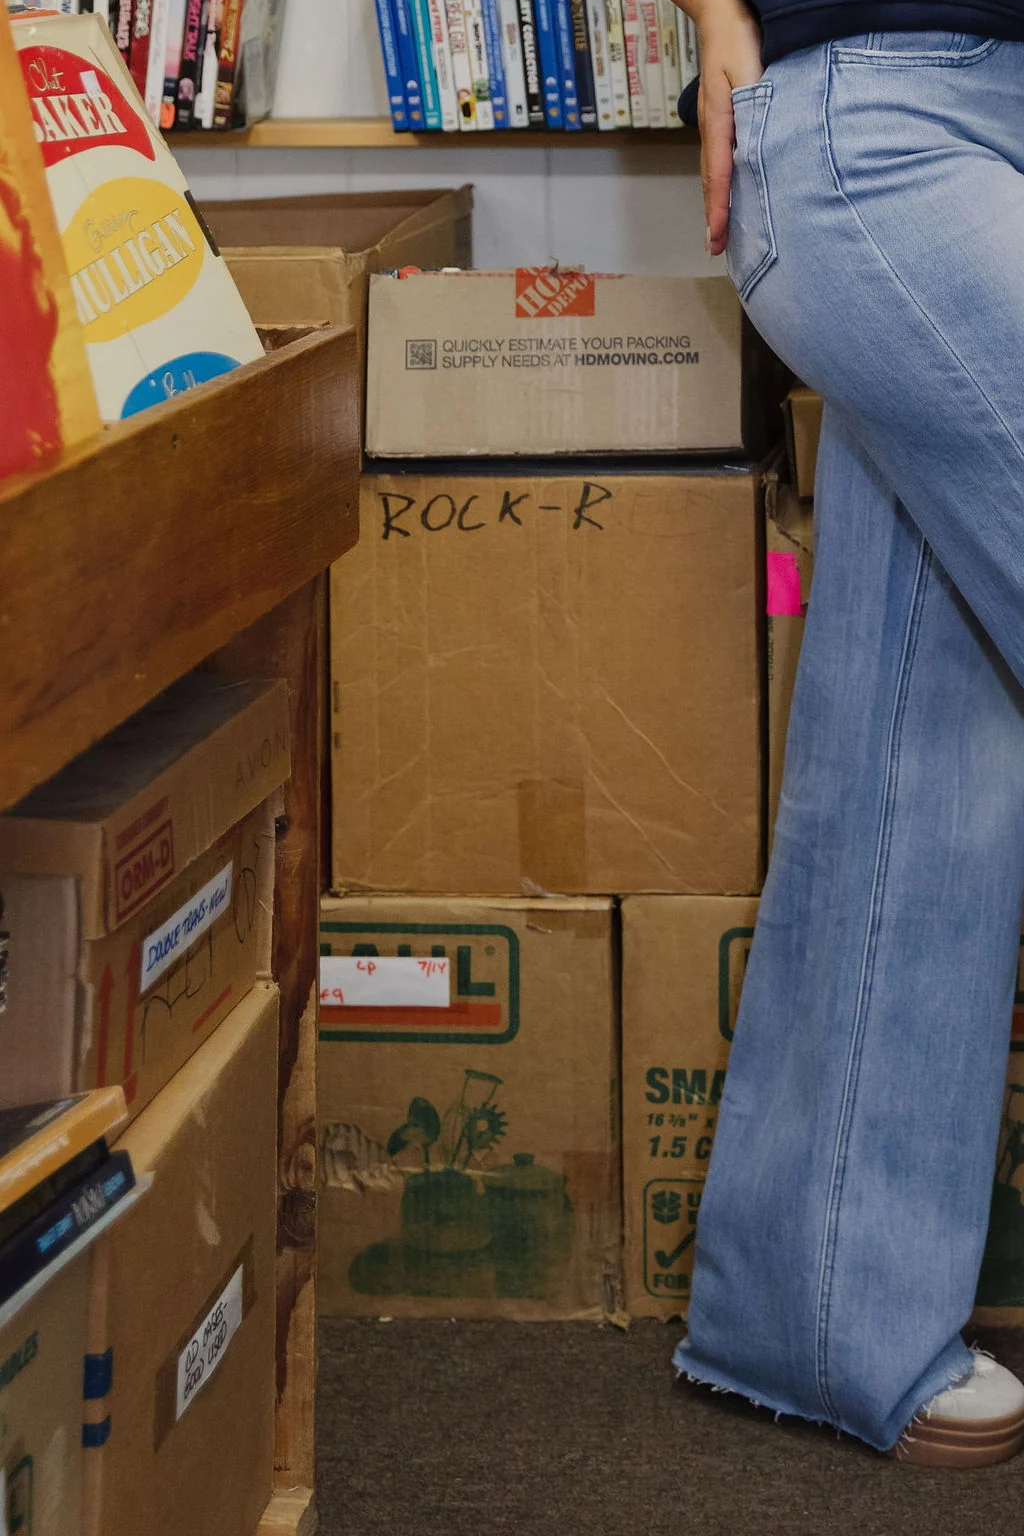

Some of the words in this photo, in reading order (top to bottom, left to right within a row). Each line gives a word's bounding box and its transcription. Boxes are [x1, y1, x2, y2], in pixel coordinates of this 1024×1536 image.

[183, 27, 199, 61] TALK
[523, 25, 538, 94] COLLECTION
[442, 339, 505, 352] QUICKLY
[509, 338, 577, 351] ESTIMATE
[581, 337, 623, 350] YOUR
[626, 336, 691, 349] PACKING
[442, 355, 499, 369] SUPPLY
[502, 355, 549, 368] NEEDS
[553, 355, 572, 366] AT
[575, 352, 699, 366] HDMOVING.COM
[146, 934, 181, 973] DOUBLE
[648, 1135, 687, 1159] 1.5
